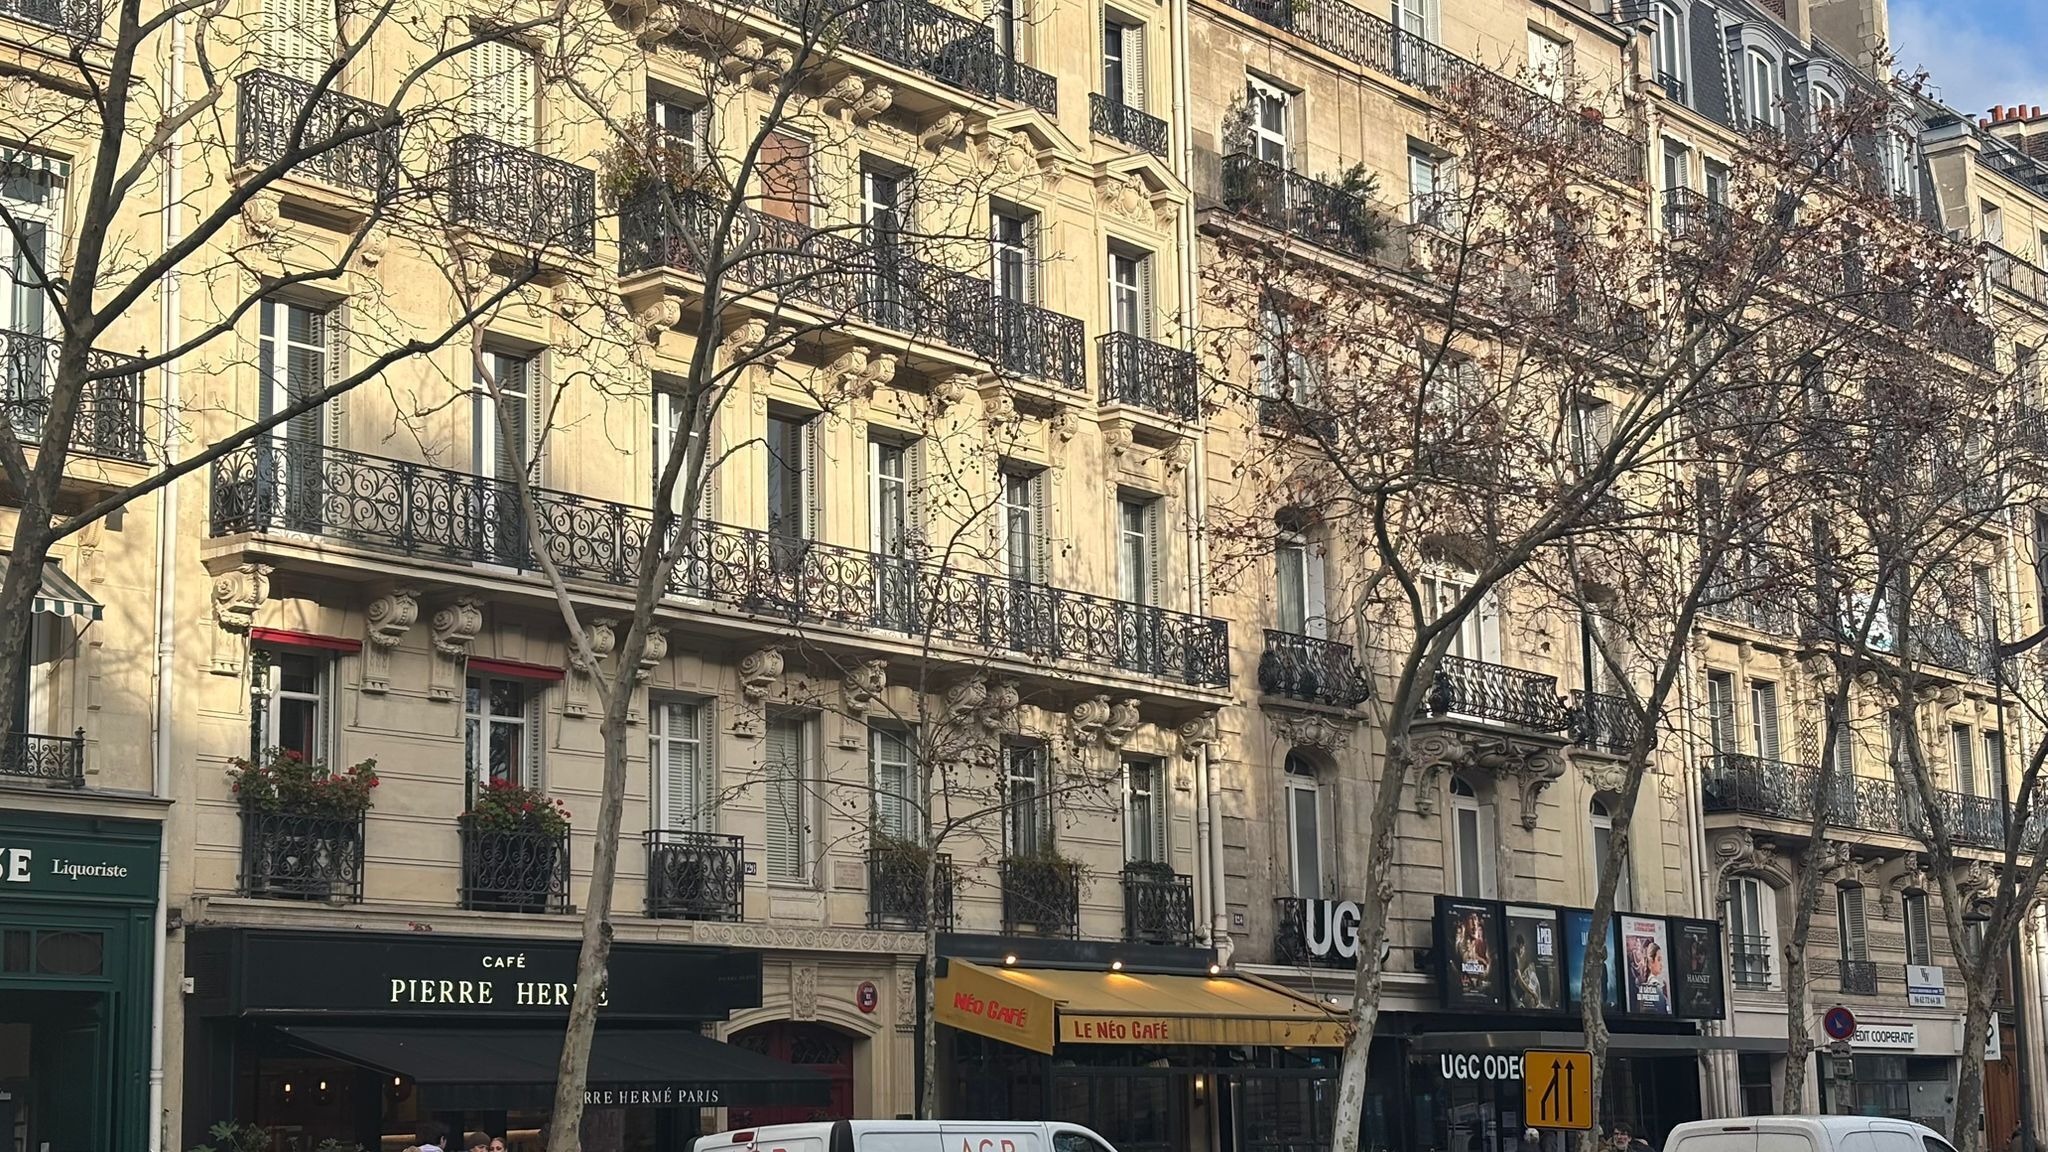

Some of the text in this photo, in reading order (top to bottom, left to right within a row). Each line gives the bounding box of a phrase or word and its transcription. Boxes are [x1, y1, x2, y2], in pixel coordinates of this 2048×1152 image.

[51, 859, 127, 880] Liquoriste
[1306, 898, 1389, 959] UG
[482, 953, 526, 968] CAFÉ
[390, 979, 493, 1004] PIERRE
[954, 992, 1028, 1027] NÉO CAFÉ
[1074, 1019, 1169, 1040] LE NÉO CAFÉ
[1441, 1053, 1480, 1079] UGC
[584, 1086, 719, 1104] RRE HERMÉ PARIS
